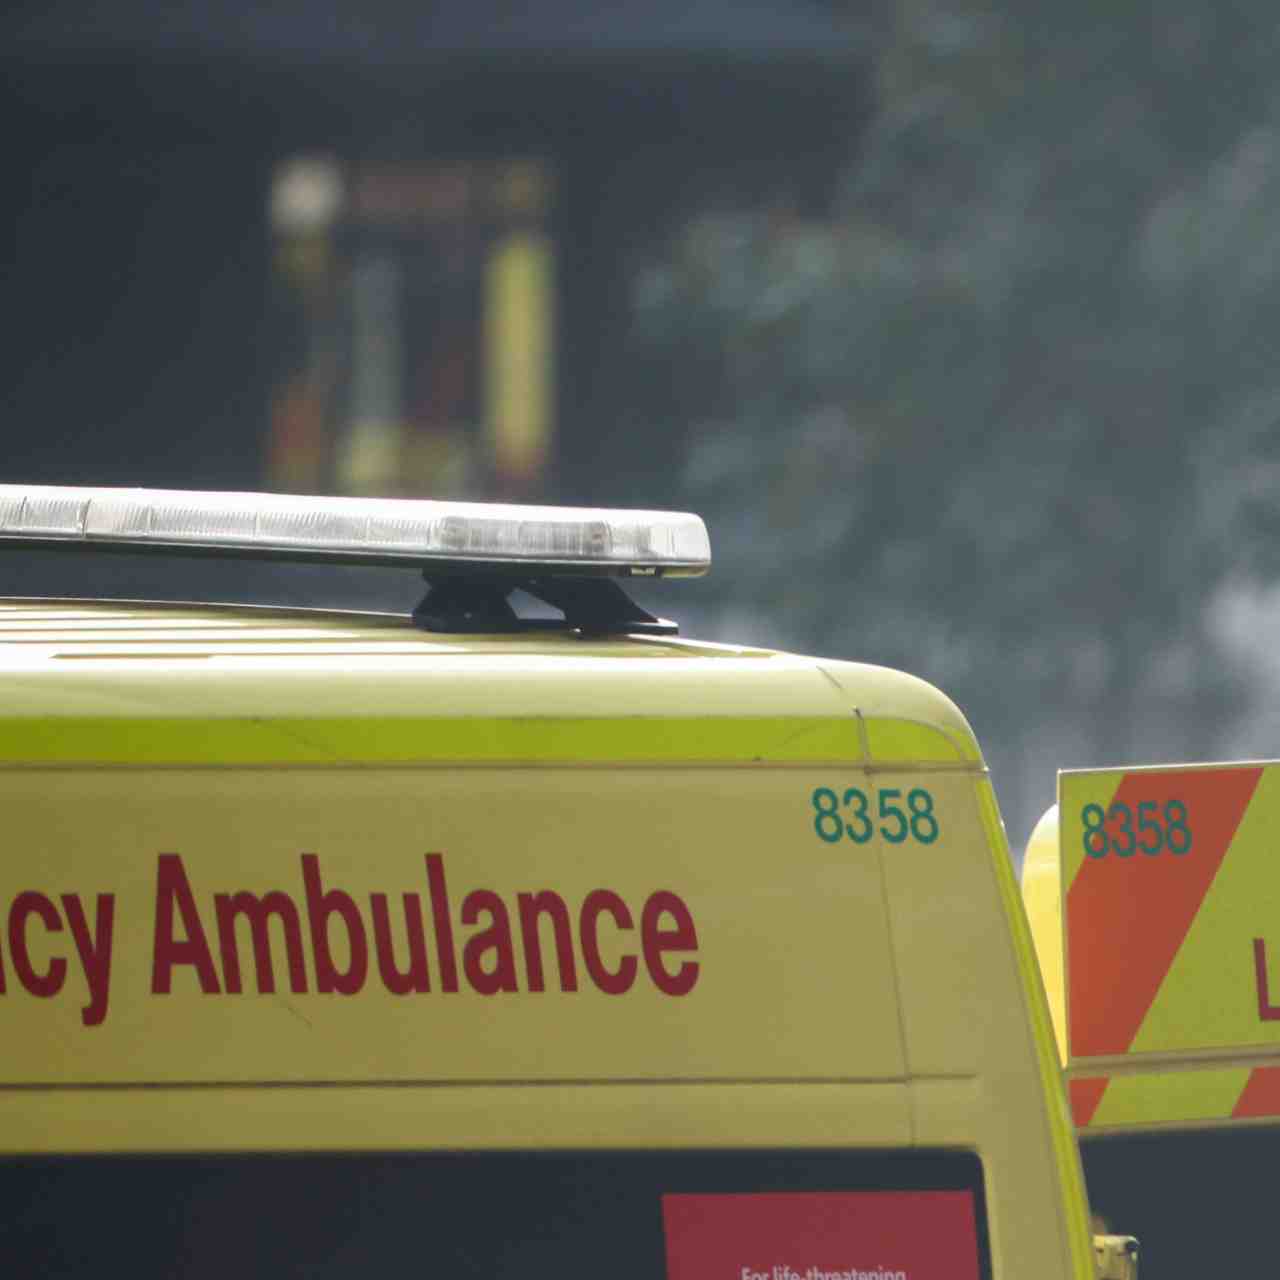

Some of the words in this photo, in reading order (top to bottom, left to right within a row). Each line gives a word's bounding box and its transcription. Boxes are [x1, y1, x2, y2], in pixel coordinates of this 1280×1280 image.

[813, 787, 938, 844] 8358
[1081, 800, 1192, 859] 8358
[0, 890, 115, 1027] cy
[151, 853, 700, 996] Ambulance
